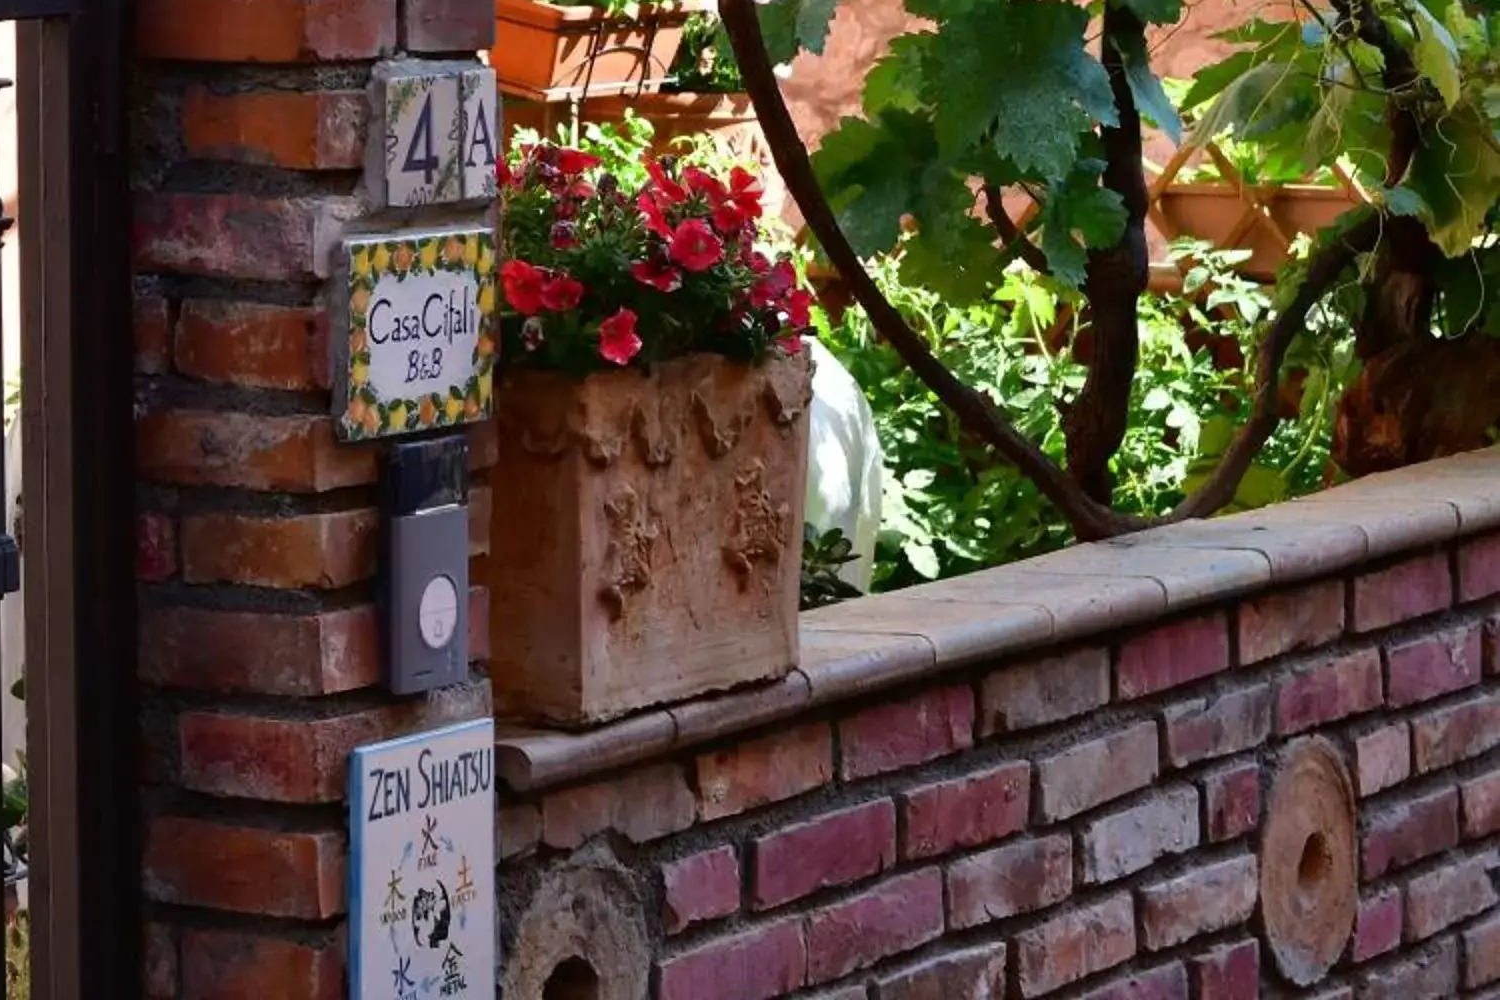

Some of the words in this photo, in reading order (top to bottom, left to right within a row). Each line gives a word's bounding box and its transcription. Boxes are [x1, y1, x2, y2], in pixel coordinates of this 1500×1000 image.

[402, 92, 440, 185] 4
[464, 99, 495, 168] A
[404, 347, 444, 383] B&B
[368, 767, 411, 822] ZEN
